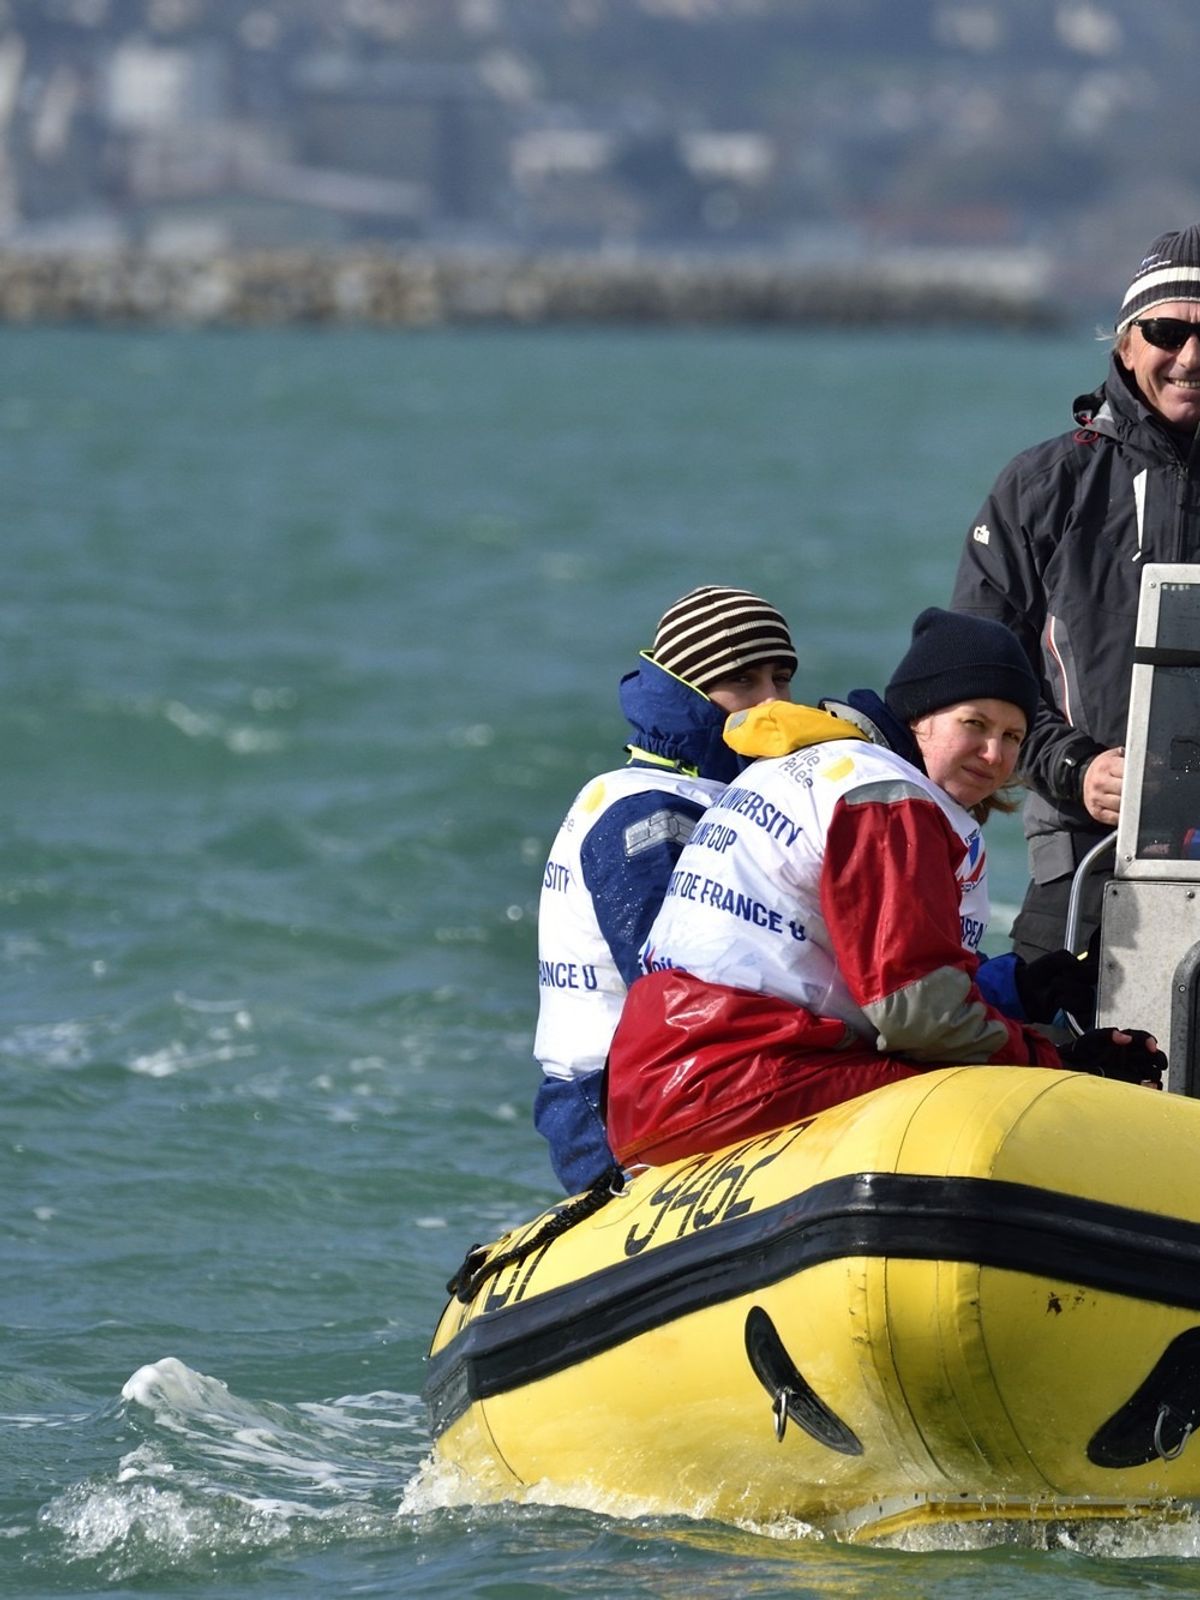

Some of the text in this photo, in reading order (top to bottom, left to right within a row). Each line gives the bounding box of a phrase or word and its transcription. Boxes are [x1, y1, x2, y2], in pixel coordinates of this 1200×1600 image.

[706, 824, 738, 854] CUP
[700, 878, 784, 934] FRANCE
[581, 963, 598, 991] U
